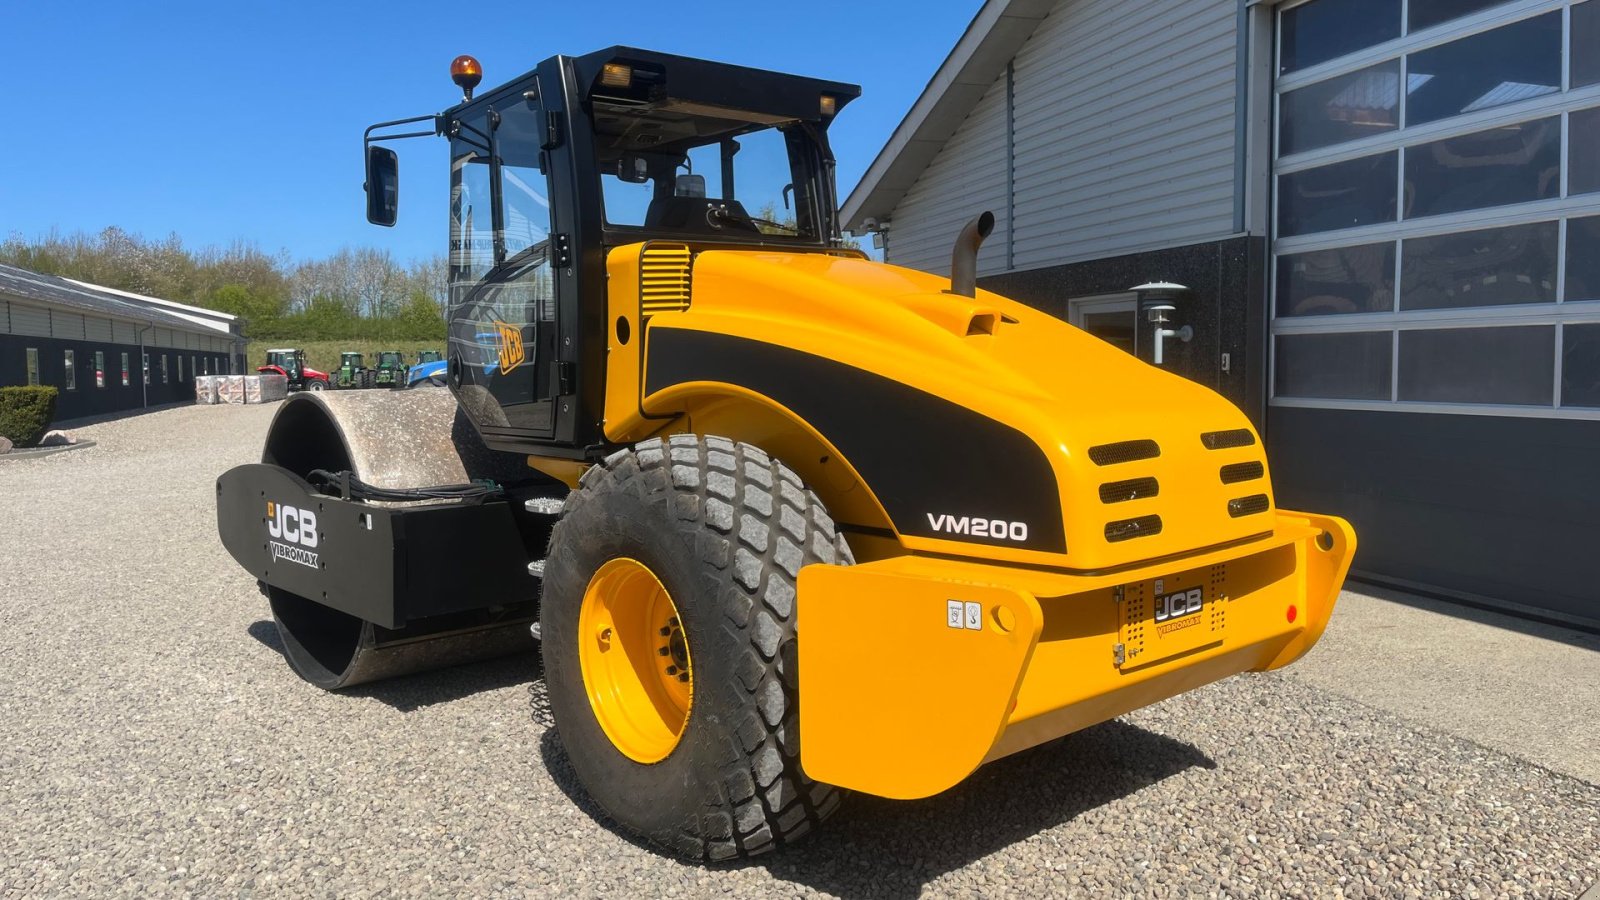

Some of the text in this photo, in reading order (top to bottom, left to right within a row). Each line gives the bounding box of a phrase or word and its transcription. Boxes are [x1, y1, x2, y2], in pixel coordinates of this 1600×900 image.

[498, 325, 523, 369] JCB
[267, 502, 318, 548] JCB
[926, 512, 1028, 541] VM200
[269, 540, 319, 569] VIBROMAX
[1155, 588, 1202, 621] JCB
[1156, 615, 1202, 640] VIBROMAX
